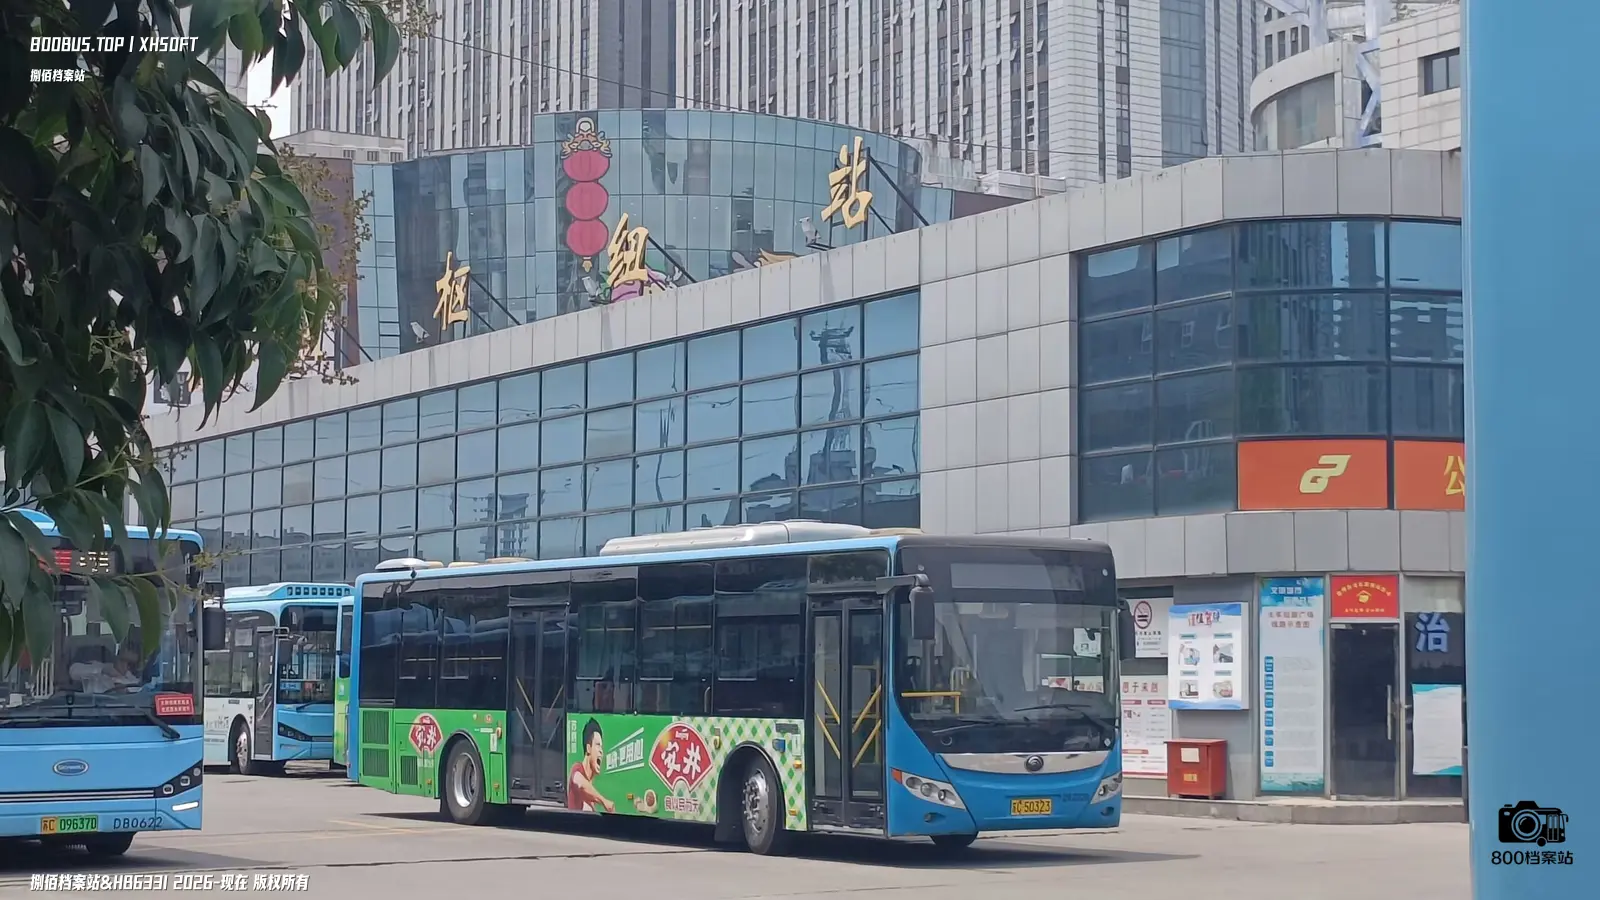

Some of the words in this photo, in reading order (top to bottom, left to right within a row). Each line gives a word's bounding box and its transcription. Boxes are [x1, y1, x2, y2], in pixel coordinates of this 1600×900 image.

[1415, 612, 1450, 652] 治
[661, 741, 702, 780] 安井
[113, 816, 163, 830] DB0622
